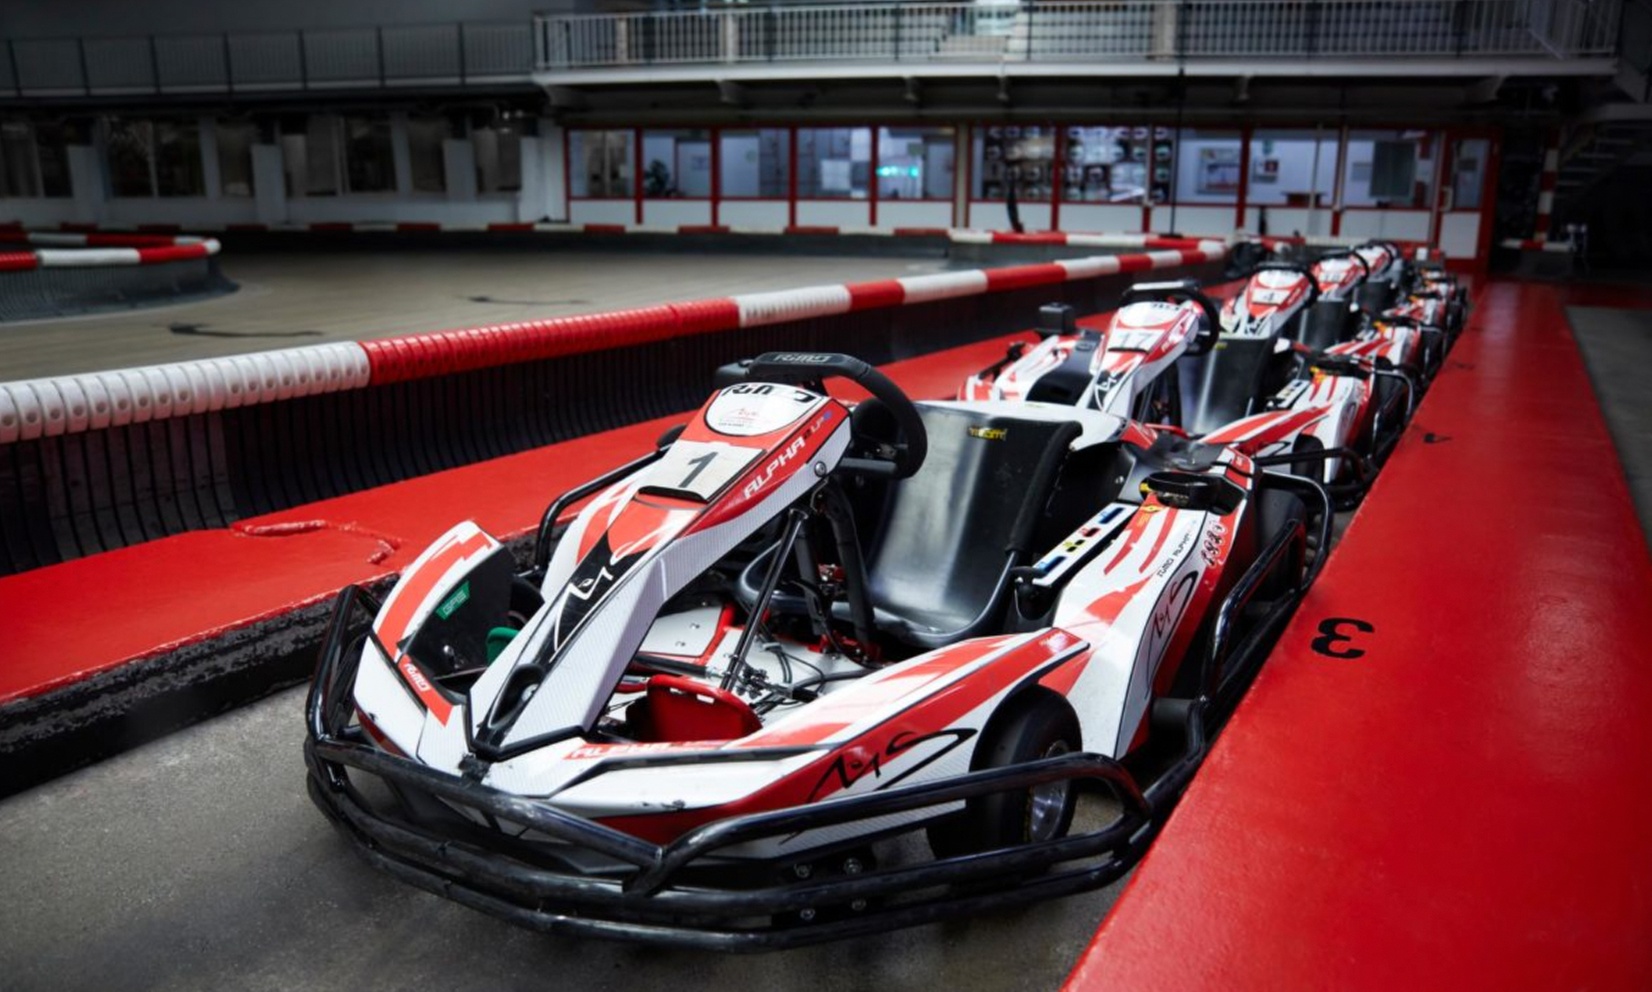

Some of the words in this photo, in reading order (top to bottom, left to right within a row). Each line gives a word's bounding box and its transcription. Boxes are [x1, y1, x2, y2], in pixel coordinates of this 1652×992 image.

[1118, 332, 1155, 350] 17
[678, 451, 719, 489] 1
[742, 435, 807, 500] ALPHA
[1310, 617, 1375, 660] 3
